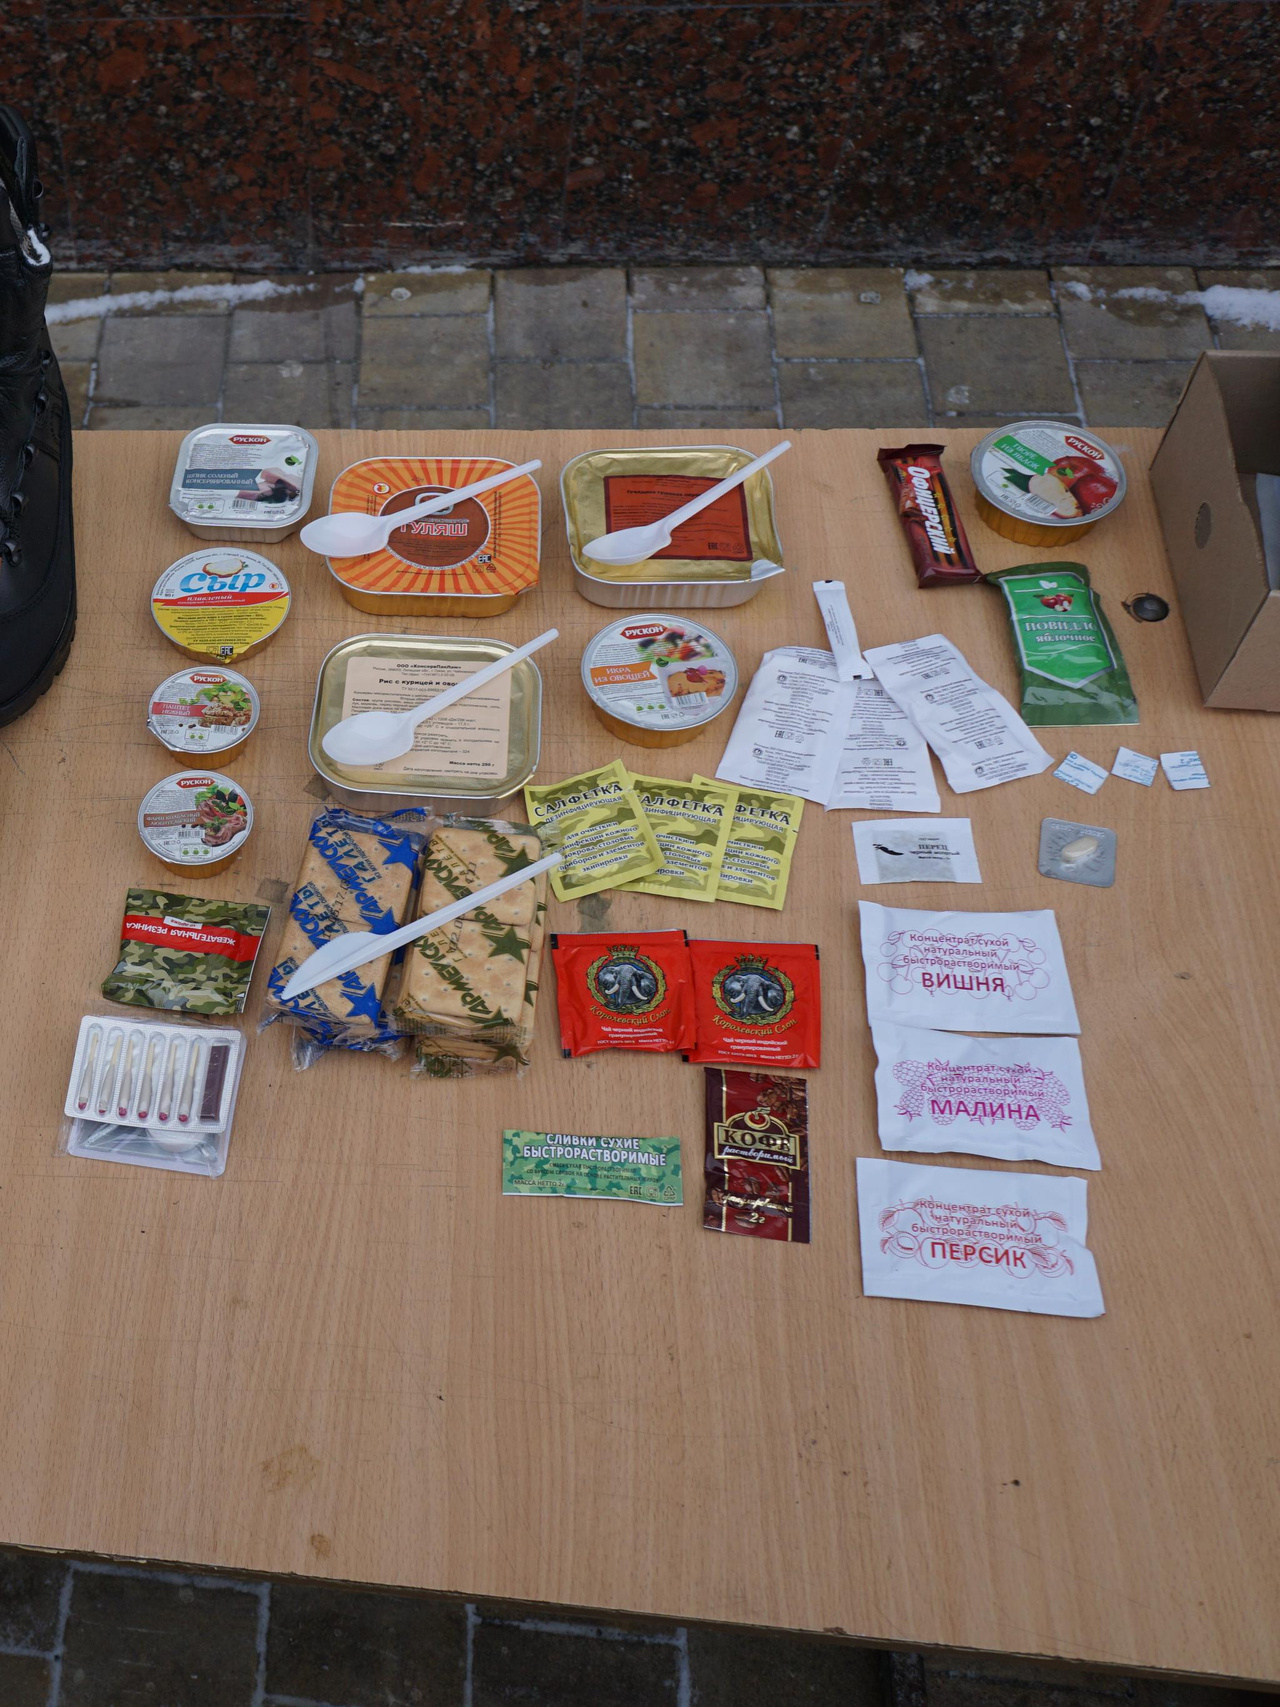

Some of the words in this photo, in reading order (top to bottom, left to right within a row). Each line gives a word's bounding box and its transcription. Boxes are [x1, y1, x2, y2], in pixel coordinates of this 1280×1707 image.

[1068, 437, 1102, 459] РУСКОН
[908, 466, 955, 554] ОФИЦЕРСКИЙ
[180, 572, 266, 592] Сыр
[624, 626, 664, 636] РУСКОН
[1025, 621, 1095, 632] ПОВИДЛО
[1036, 632, 1096, 643] яблочное
[534, 784, 623, 817] САЛФЕТКА
[638, 795, 724, 816] АЛФЕТКА
[736, 804, 790, 826] ФЕТКА
[126, 922, 168, 934] РЕЗИНКА
[170, 930, 236, 946] ЖЕВАТЕЛЬНАЯ
[910, 934, 977, 944] Концентрат
[978, 938, 1009, 948] сухой
[924, 946, 998, 958] натуральный
[903, 956, 1020, 971] быстрорастворимый
[922, 972, 1005, 992] ВИШНЯ
[590, 1005, 648, 1026] Королевский
[712, 1014, 773, 1037] Королевский
[928, 1062, 996, 1073] Концентрат
[920, 1083, 1044, 1097] быстрорастворимый
[942, 1075, 1020, 1086] натуральный
[931, 1100, 1040, 1121] МАЛИНА
[546, 1134, 596, 1147] СЛИВКИ
[600, 1136, 640, 1150] СУХИЕ
[724, 1130, 790, 1150] КОФЕ
[523, 1146, 667, 1166] БЫСТРОРАСТВОРИМЫЕ
[920, 1200, 990, 1214] Концентрат
[996, 1207, 1030, 1218] сухой
[934, 1214, 1018, 1228] натуральный
[912, 1223, 1042, 1243] быстрорастворимый
[930, 1241, 1026, 1269] ПЕРСИК
